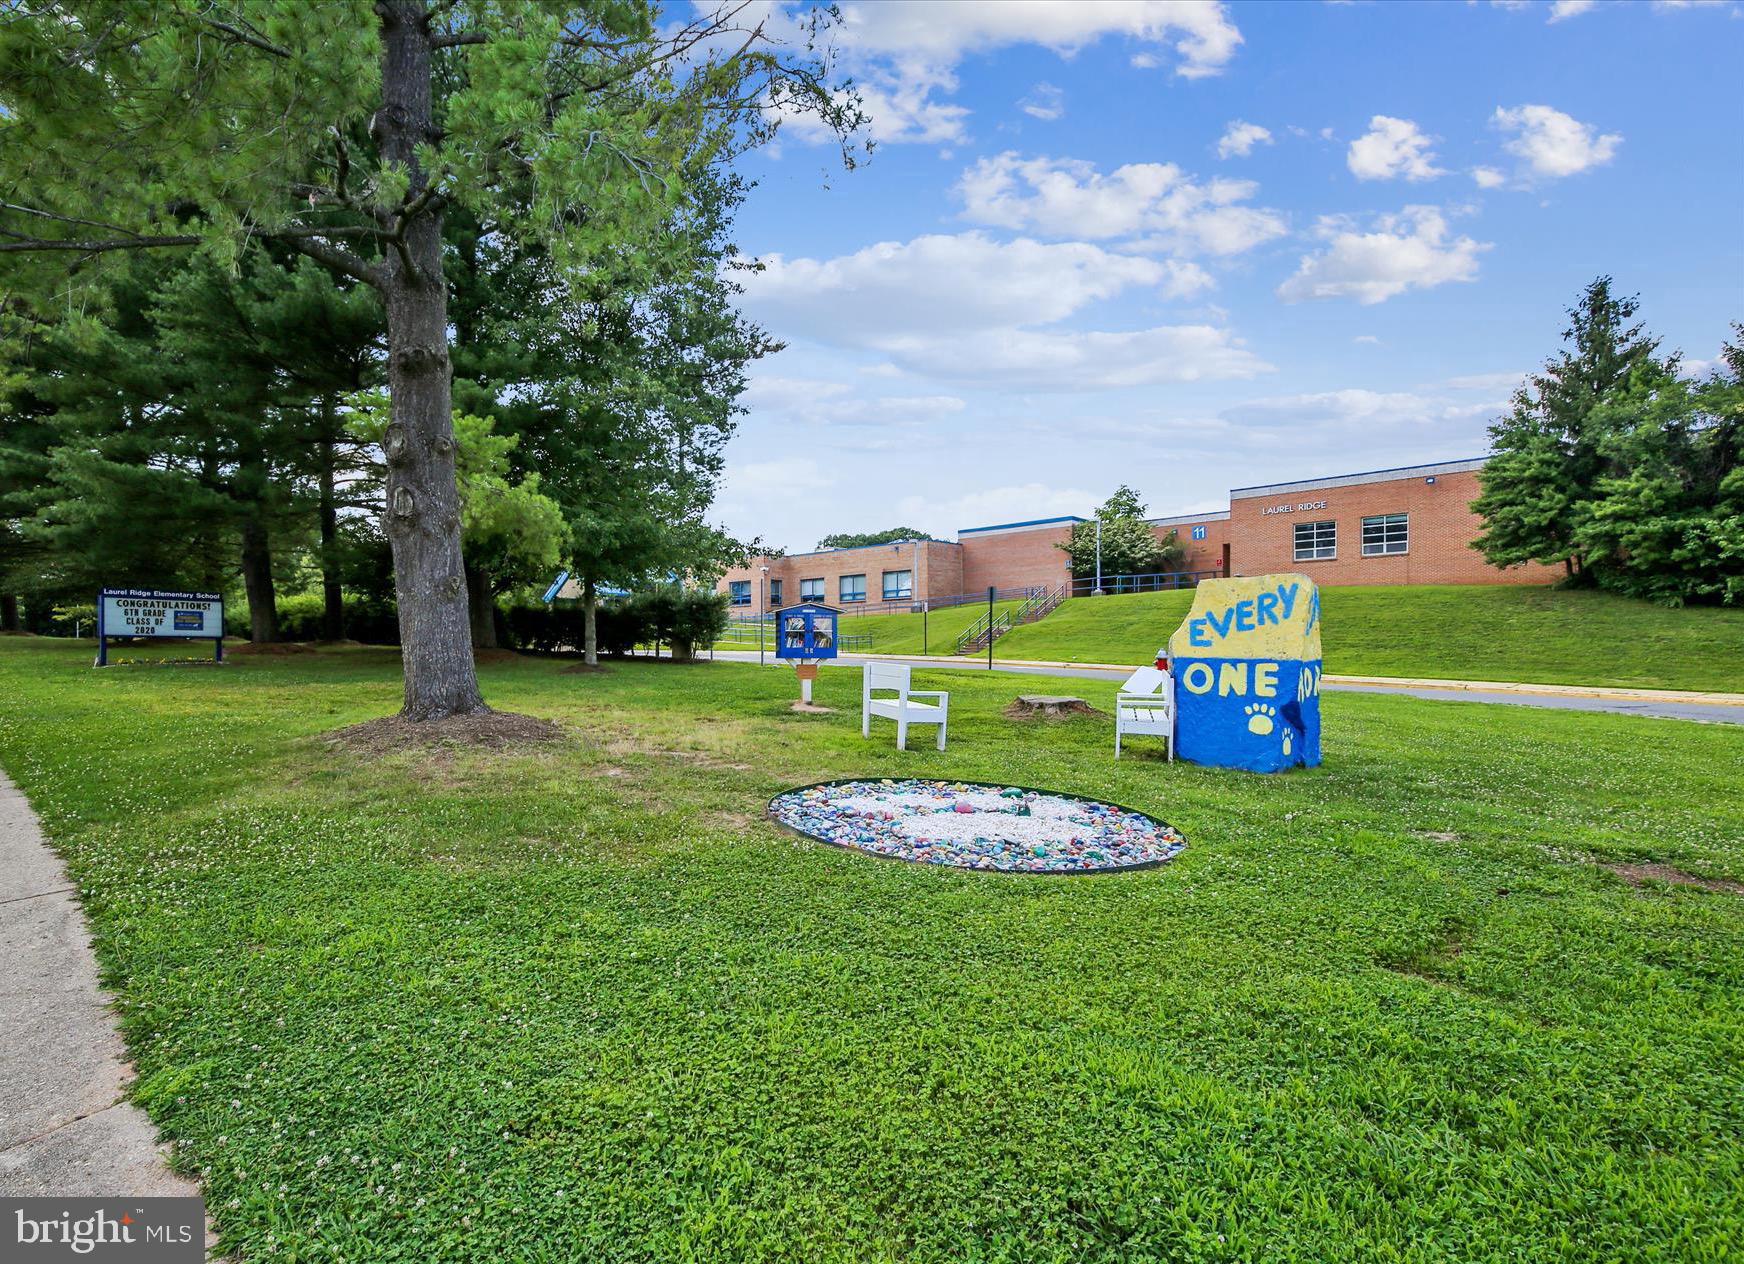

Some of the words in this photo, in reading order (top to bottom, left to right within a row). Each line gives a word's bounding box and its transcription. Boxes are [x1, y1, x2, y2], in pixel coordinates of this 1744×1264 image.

[1262, 505, 1294, 515] LAUREL
[1298, 500, 1327, 511] RIDGE
[1193, 526, 1205, 539] 11
[116, 599, 211, 610] CONGRATULATIONS!
[124, 609, 139, 617] 6TH
[142, 609, 167, 617] GRADE
[1189, 583, 1299, 647] EVERY
[126, 617, 151, 625] CLASS
[135, 626, 155, 634] 2020
[1182, 663, 1279, 697] ONE
